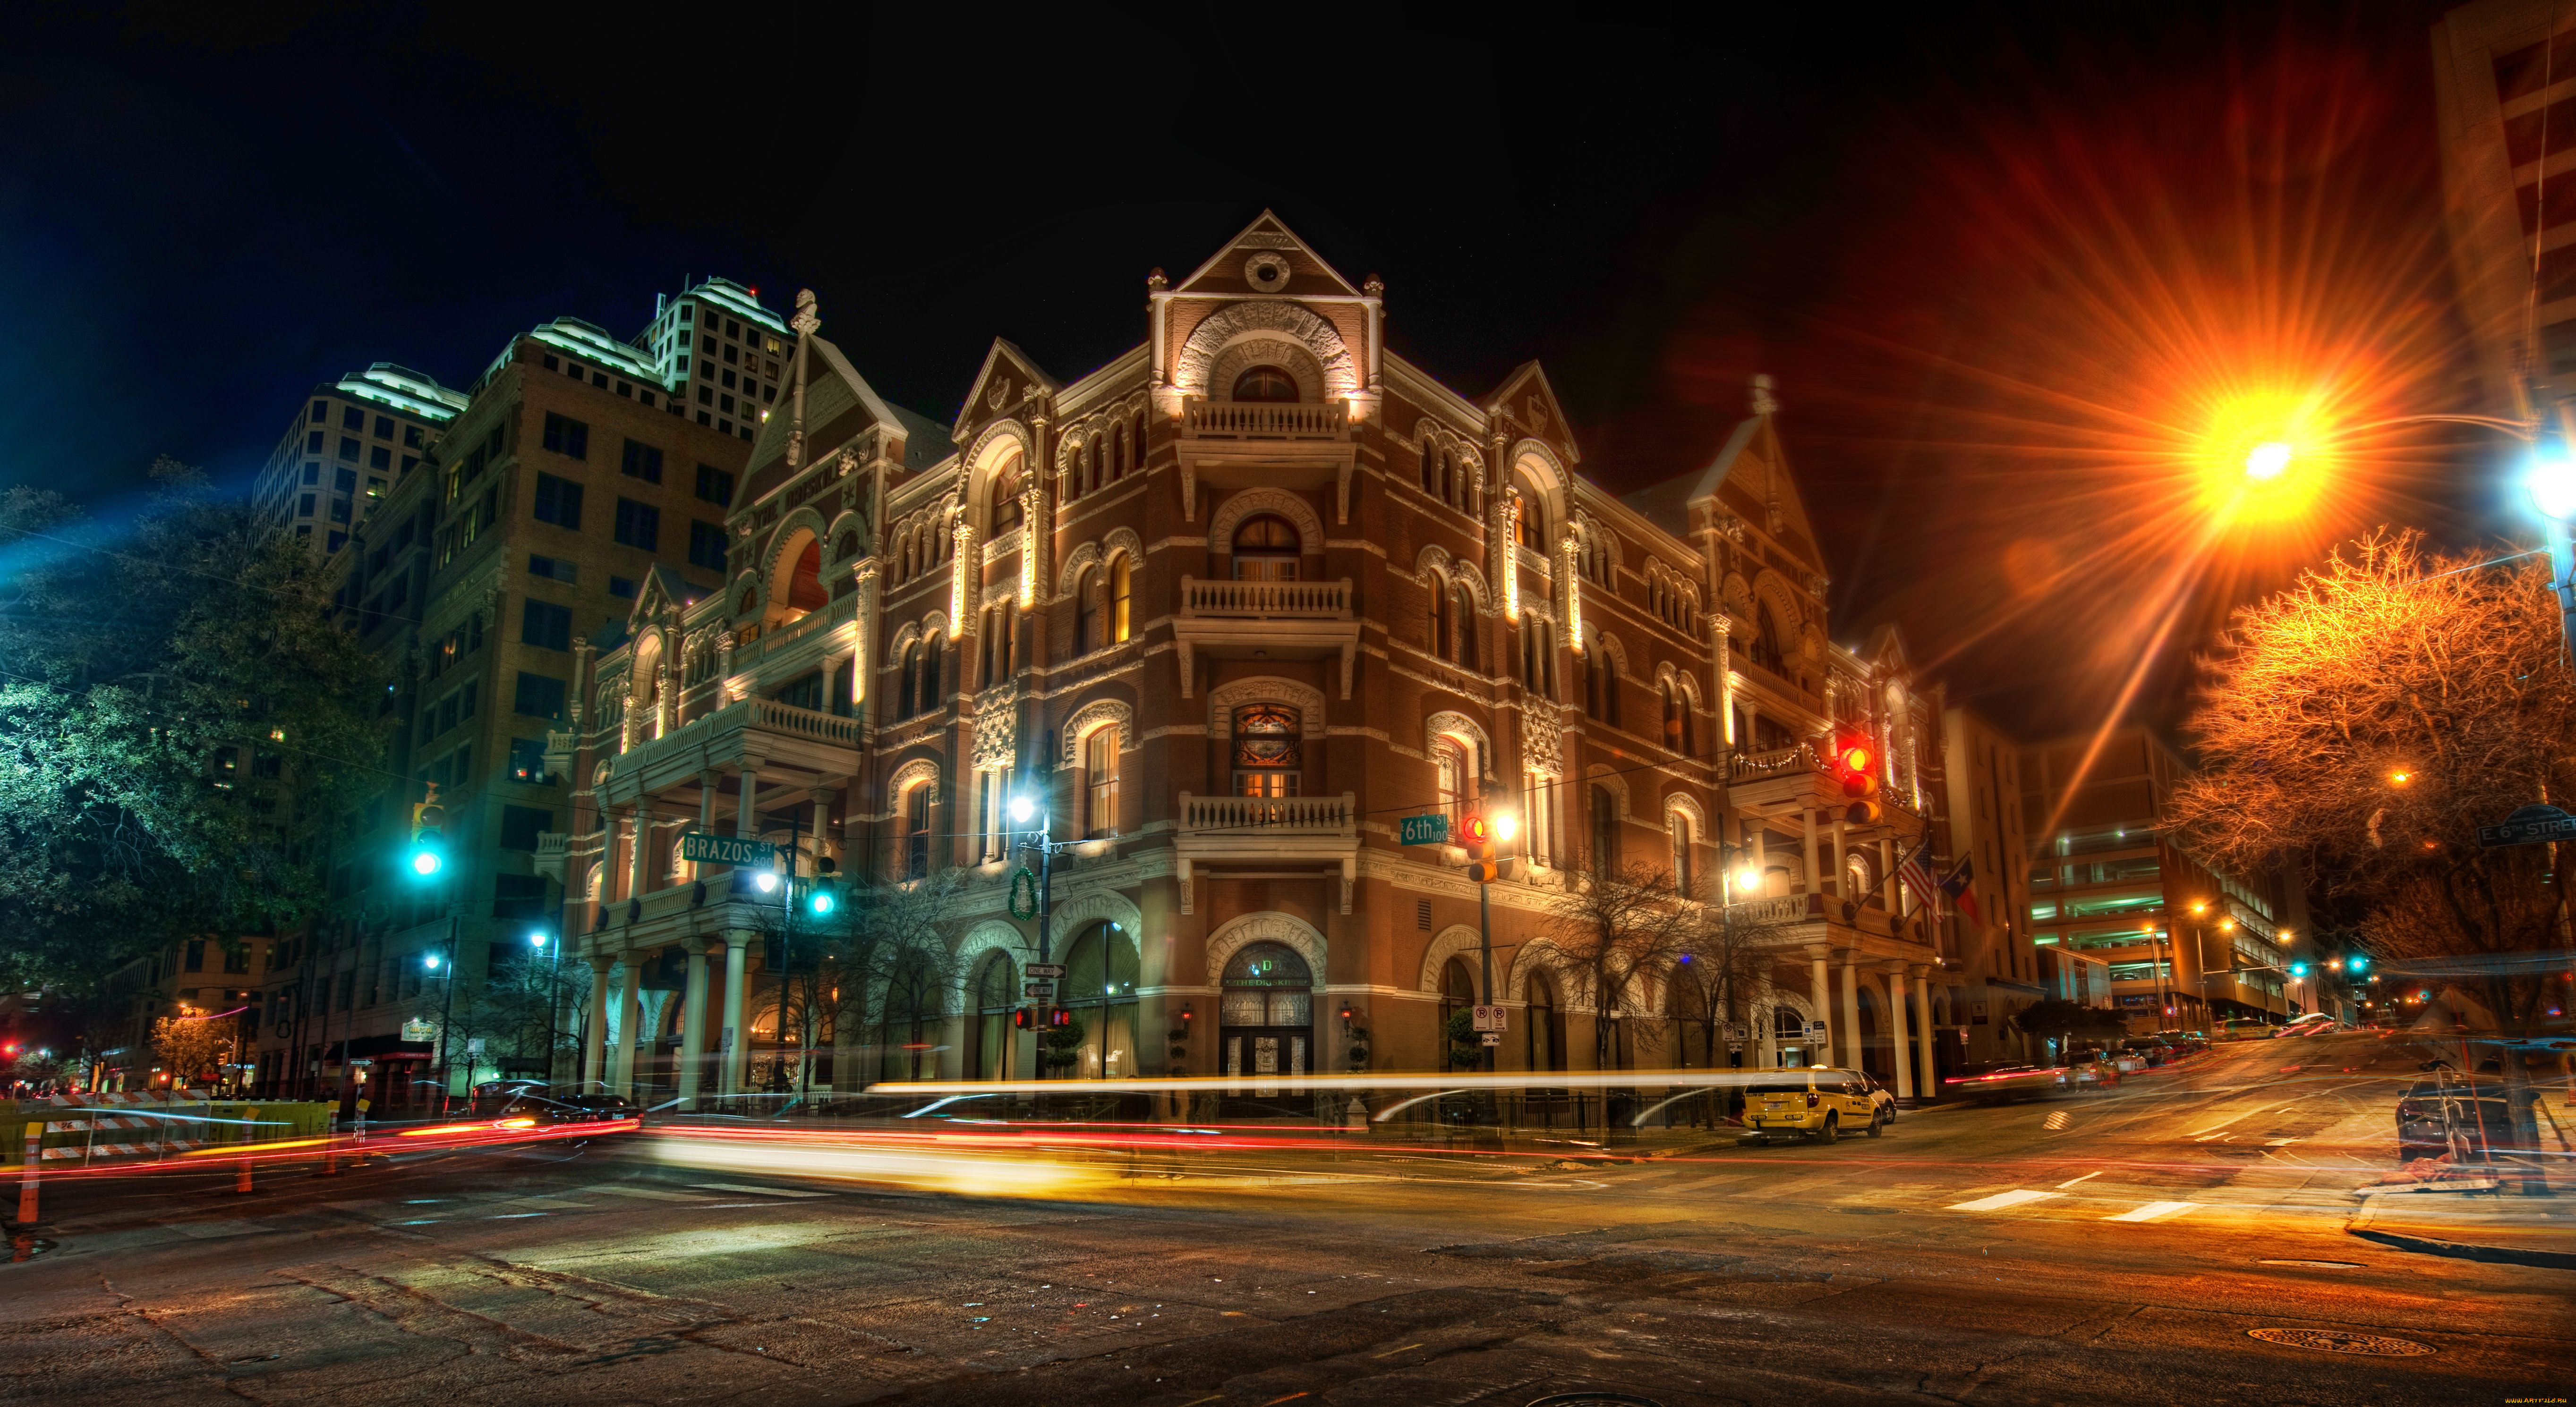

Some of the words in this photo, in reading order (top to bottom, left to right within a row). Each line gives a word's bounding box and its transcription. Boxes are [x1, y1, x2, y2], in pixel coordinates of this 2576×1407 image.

[755, 500, 778, 530] THE
[1406, 819, 1432, 840] 6th
[1436, 814, 1447, 825] ST
[1433, 830, 1447, 841] 100
[2499, 824, 2523, 838] 6TH
[2526, 818, 2576, 835] STRE
[686, 837, 752, 863] BRAZOS
[759, 842, 772, 852] ST
[753, 856, 773, 867] 600
